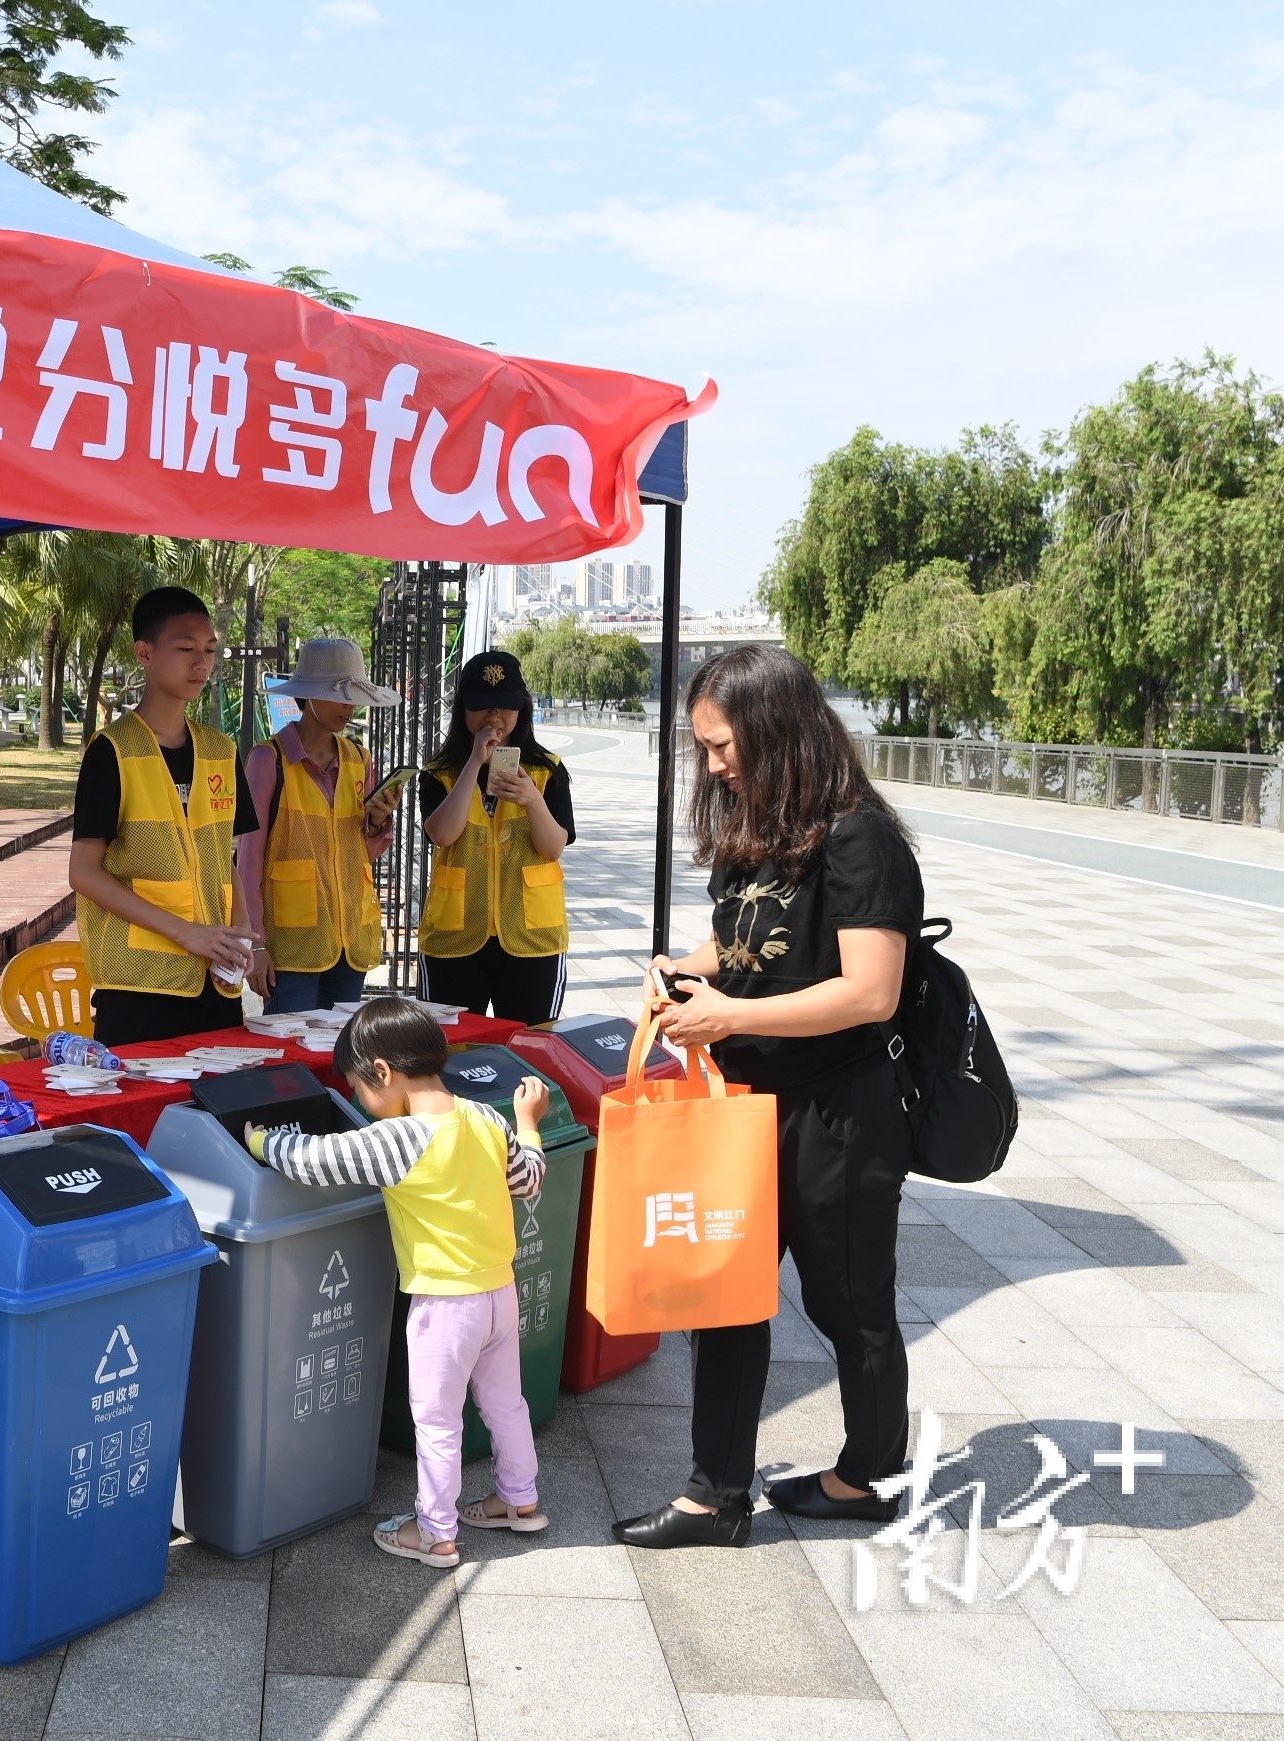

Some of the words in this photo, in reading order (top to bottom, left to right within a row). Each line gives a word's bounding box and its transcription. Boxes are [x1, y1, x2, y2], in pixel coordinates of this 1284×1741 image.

[594, 1034, 626, 1048] PUSH
[459, 1064, 497, 1080] PUSH
[44, 1167, 102, 1190] PUSH
[311, 1302, 353, 1328] 其他垃圾
[308, 1324, 335, 1341] Residual
[336, 1318, 355, 1331] Waste
[91, 1382, 140, 1411] 可回收物
[94, 1403, 134, 1424] Recyclable
